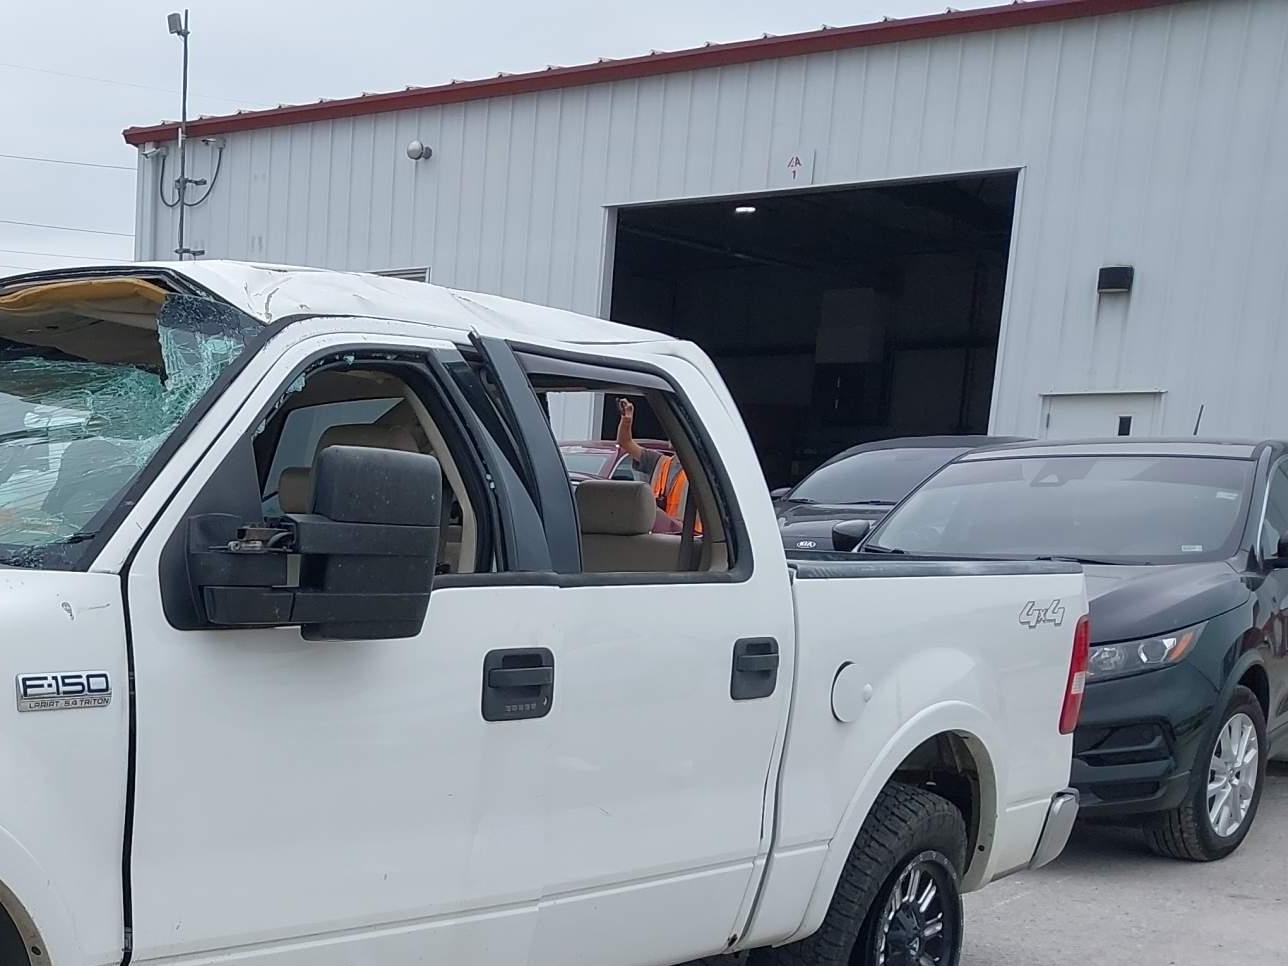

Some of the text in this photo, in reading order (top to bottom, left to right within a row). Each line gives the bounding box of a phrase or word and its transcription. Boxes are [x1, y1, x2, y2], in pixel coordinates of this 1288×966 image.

[1019, 599, 1065, 628] 4x4
[21, 673, 110, 697] F-150
[80, 697, 110, 706] TRITON
